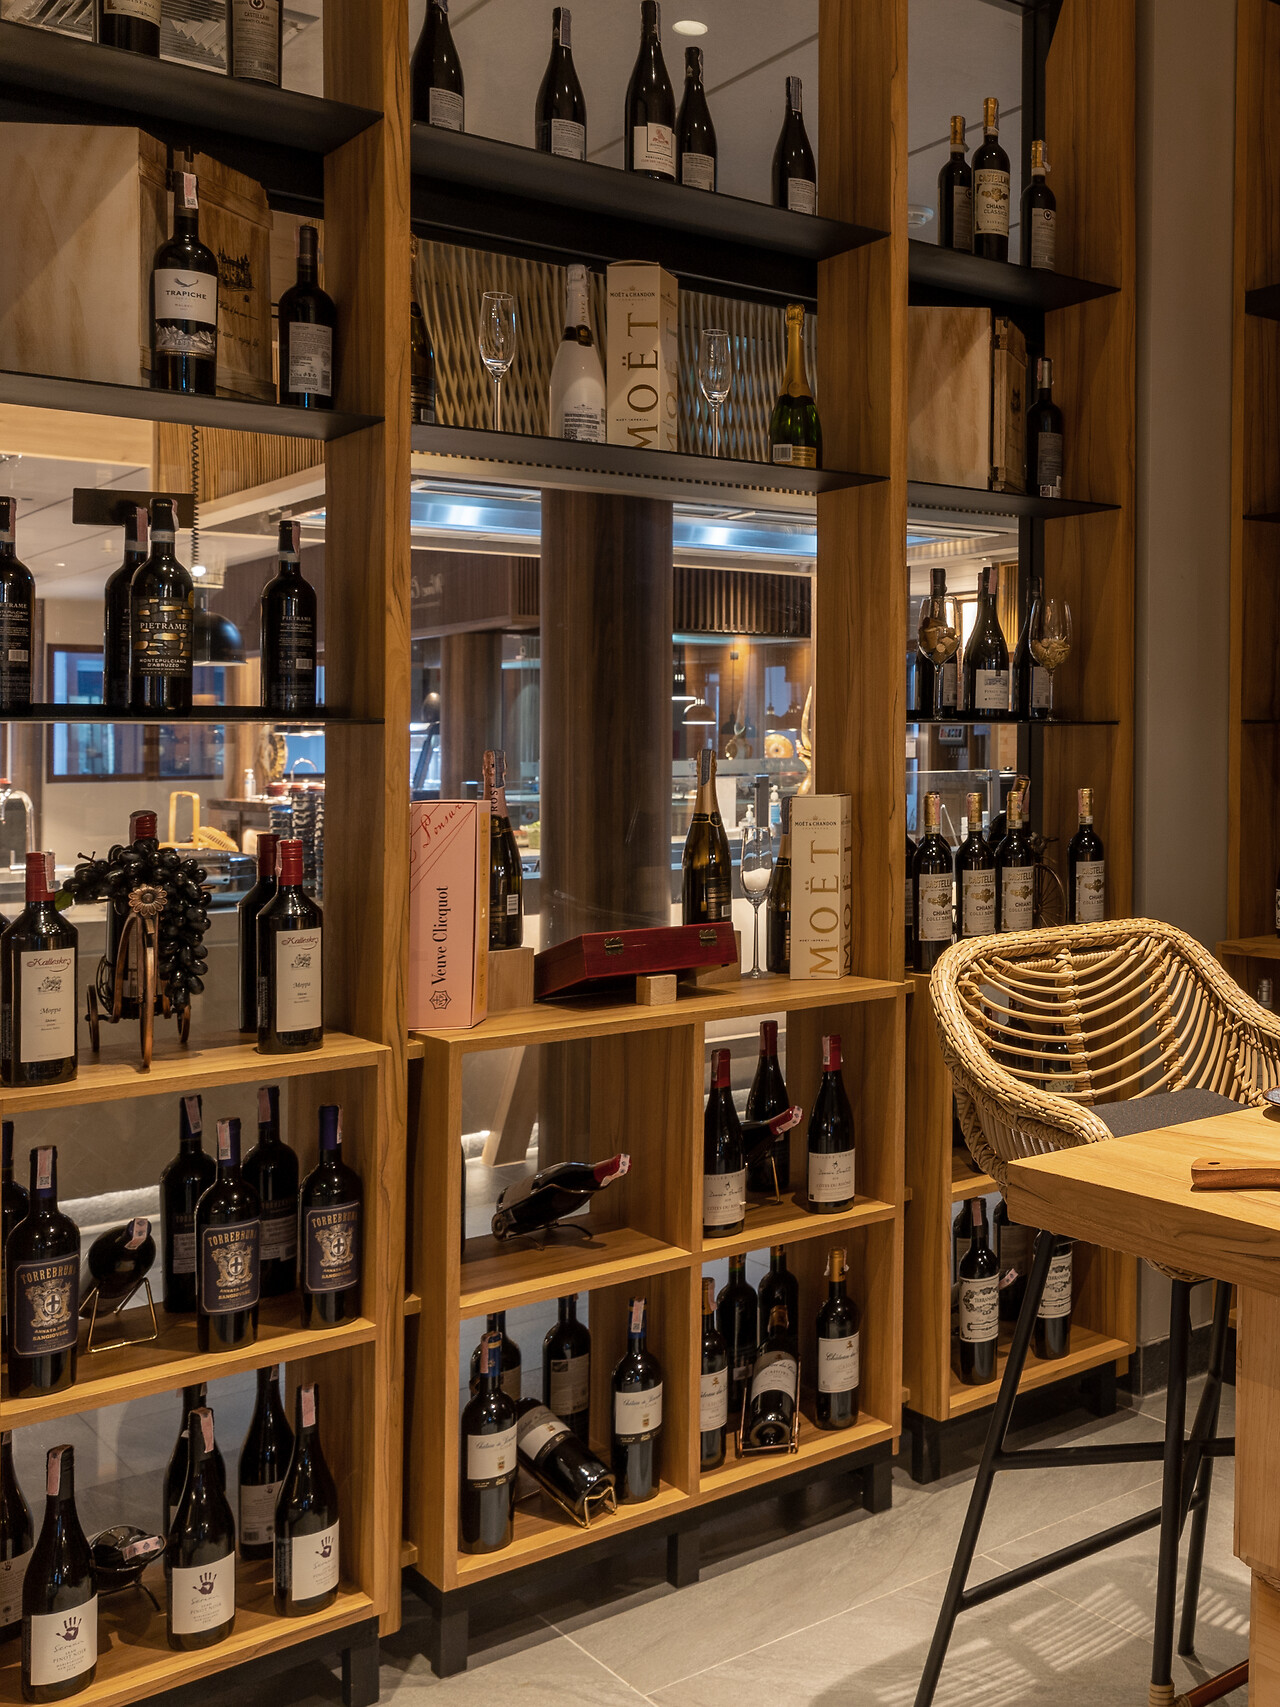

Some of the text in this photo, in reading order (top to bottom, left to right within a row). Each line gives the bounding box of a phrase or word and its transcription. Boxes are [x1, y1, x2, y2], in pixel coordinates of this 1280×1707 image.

[166, 290, 206, 300] TRAPICHE
[622, 312, 658, 448] MOËT
[140, 622, 188, 630] PIETRAME
[431, 886, 452, 986] Veuve Clicquot
[804, 840, 839, 975] MOËT
